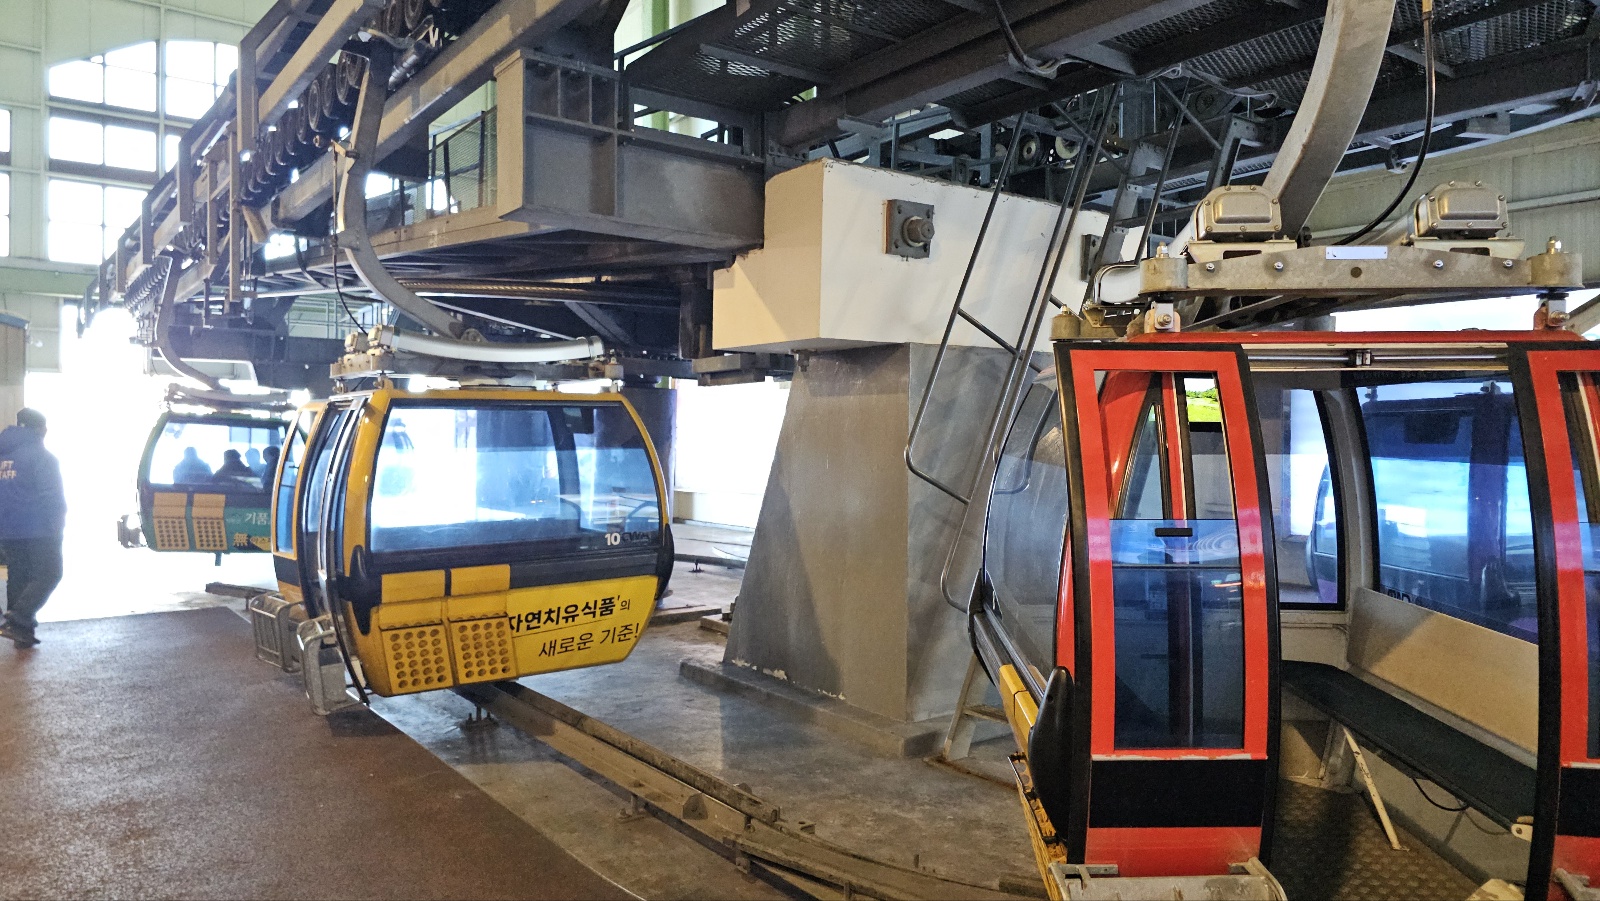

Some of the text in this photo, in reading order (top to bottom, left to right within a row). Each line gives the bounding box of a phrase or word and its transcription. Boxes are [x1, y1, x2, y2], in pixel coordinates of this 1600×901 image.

[605, 532, 621, 546] 10
[538, 622, 640, 658] 새로운 기준!
